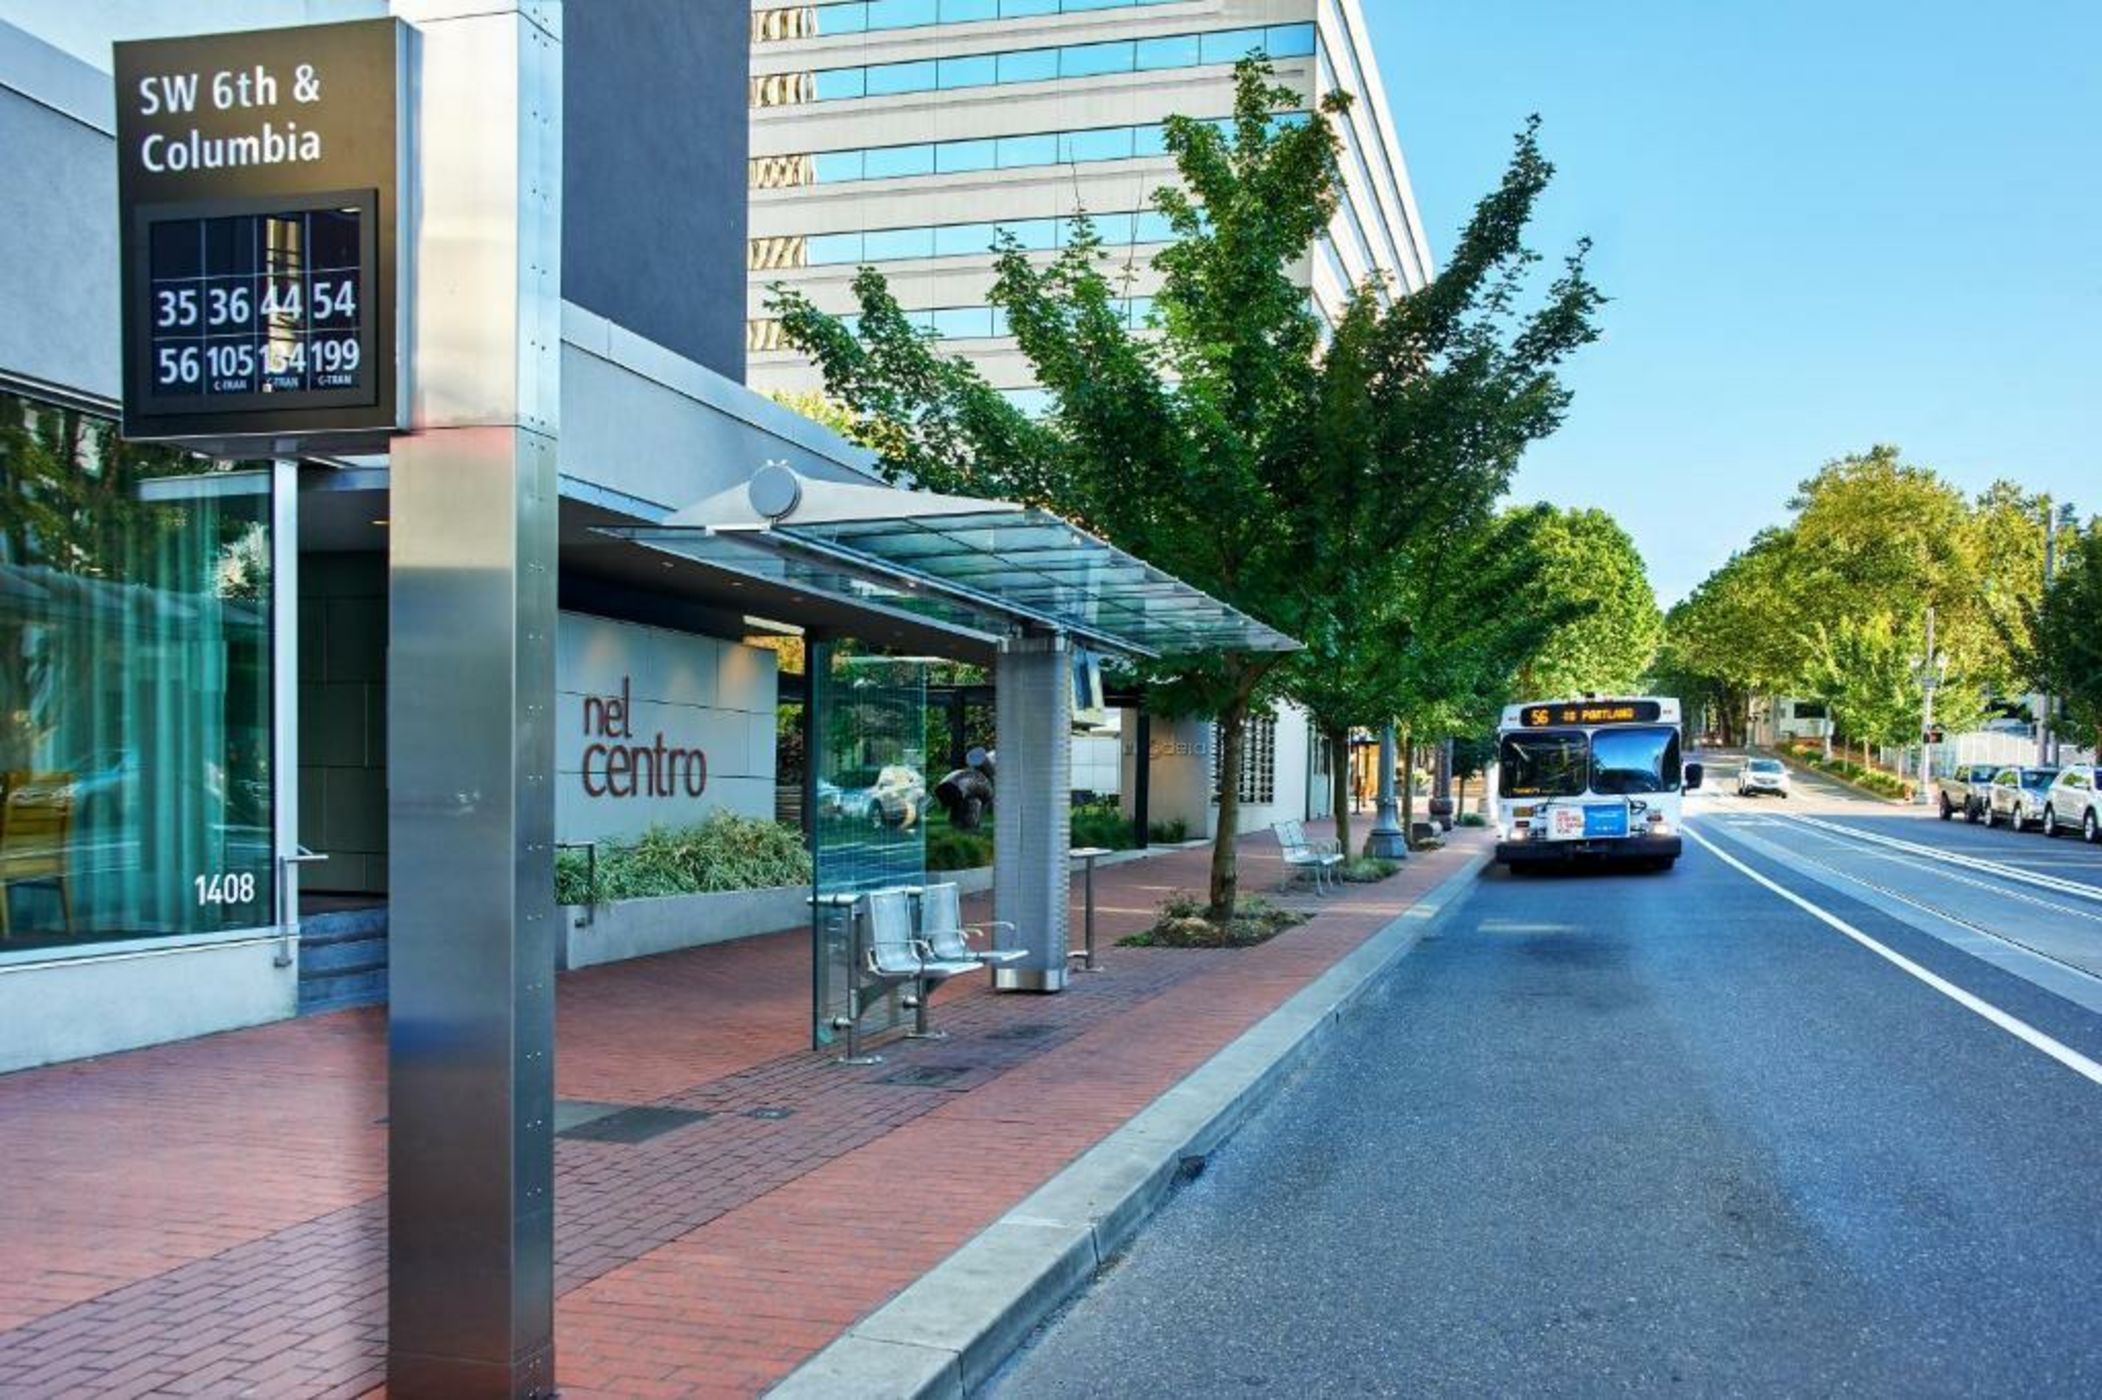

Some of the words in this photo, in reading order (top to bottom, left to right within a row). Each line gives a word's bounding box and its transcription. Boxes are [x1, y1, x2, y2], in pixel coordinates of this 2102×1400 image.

[140, 73, 198, 116] SW
[212, 65, 277, 110] 6th
[293, 64, 320, 103] &
[141, 122, 321, 173] Columbia
[157, 289, 197, 327] 35
[208, 286, 249, 325] 36
[260, 282, 302, 320] 44
[313, 280, 356, 321] 54
[159, 347, 200, 384] 56
[206, 344, 254, 378] 105
[310, 338, 360, 373] 199
[213, 379, 247, 391] C-TRAN
[317, 374, 352, 385] C-TRAN
[584, 674, 632, 738] nel
[1530, 708, 1550, 726] 56
[1581, 707, 1634, 721] PORTLAND
[582, 730, 707, 797] centro
[194, 872, 255, 906] 1408
